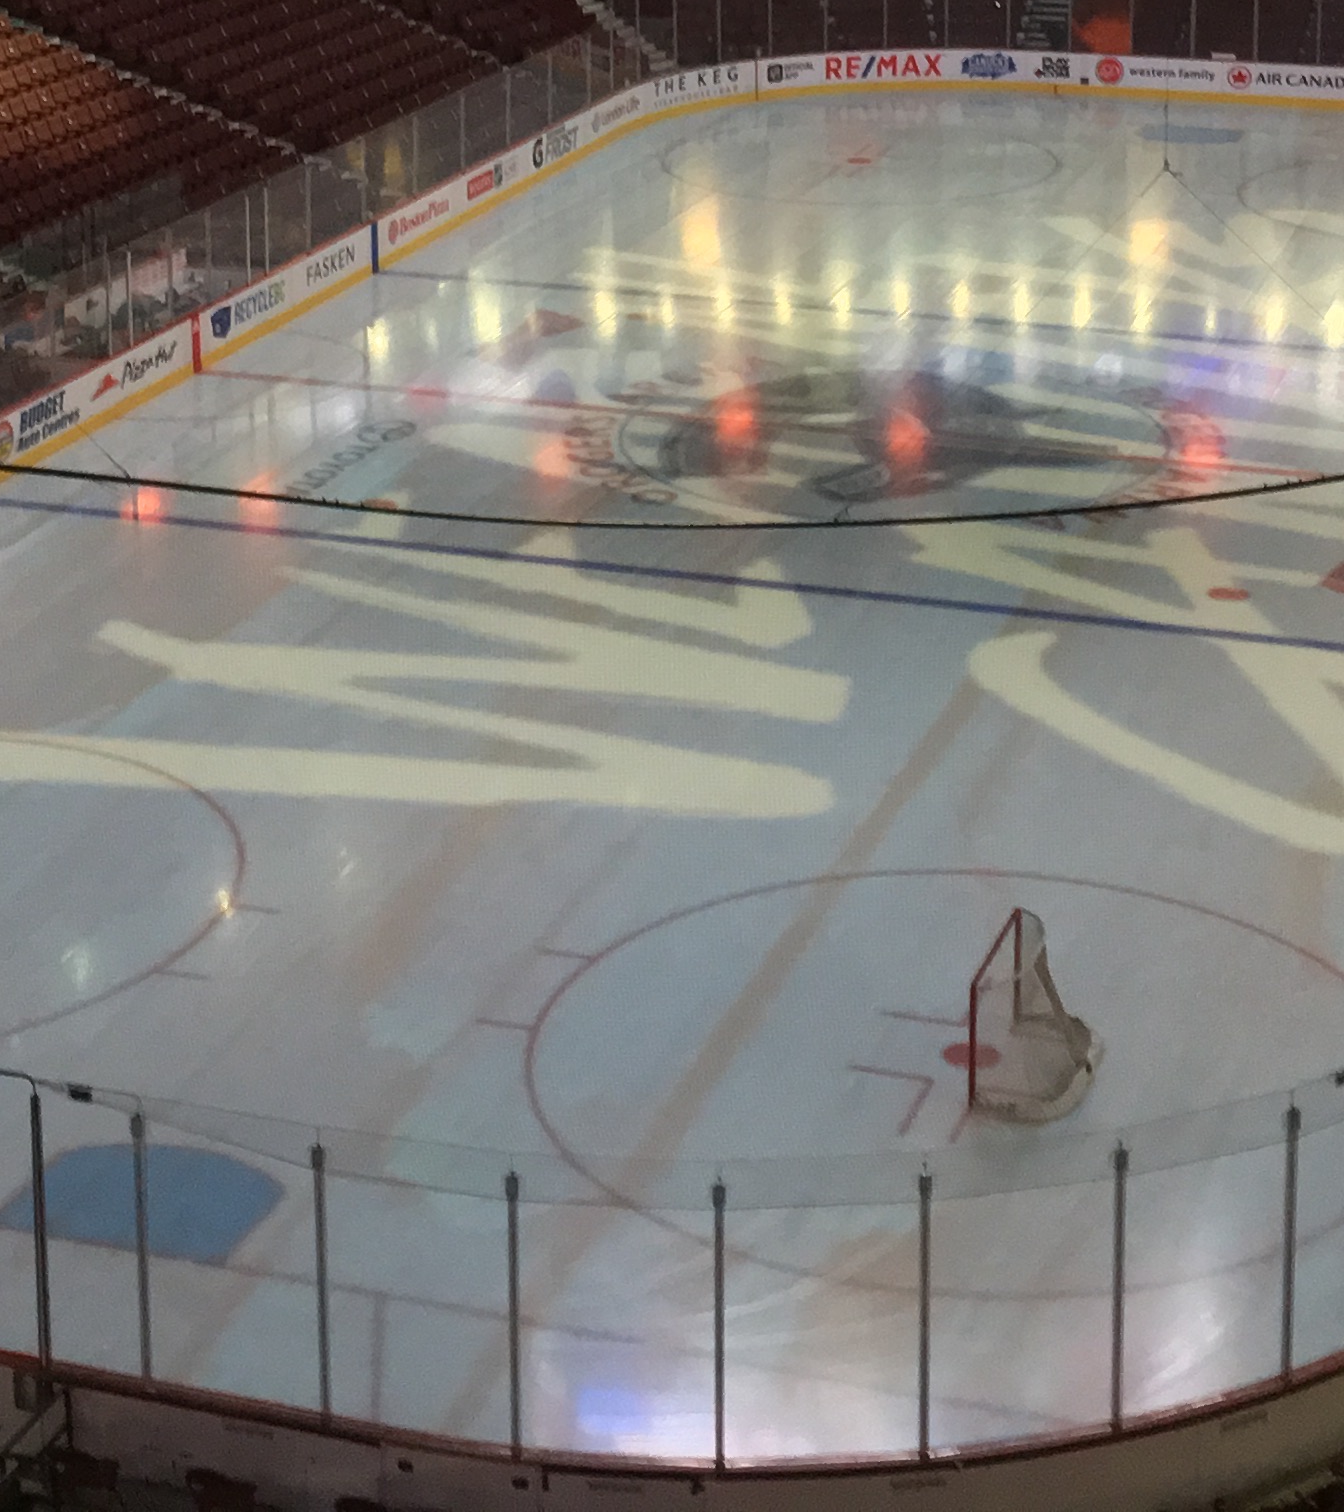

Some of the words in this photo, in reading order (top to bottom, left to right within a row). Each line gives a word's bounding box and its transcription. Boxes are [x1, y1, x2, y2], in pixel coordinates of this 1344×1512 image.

[654, 75, 687, 97] THE
[697, 66, 739, 88] KEG
[824, 53, 943, 81] RE/MAX
[1129, 67, 1177, 79] western
[1178, 68, 1216, 83] family
[1256, 72, 1282, 86] AIR
[306, 244, 355, 287] FASKEN
[19, 389, 66, 436] BUDGET
[17, 426, 42, 453] Auto
[42, 407, 81, 440] Centres
